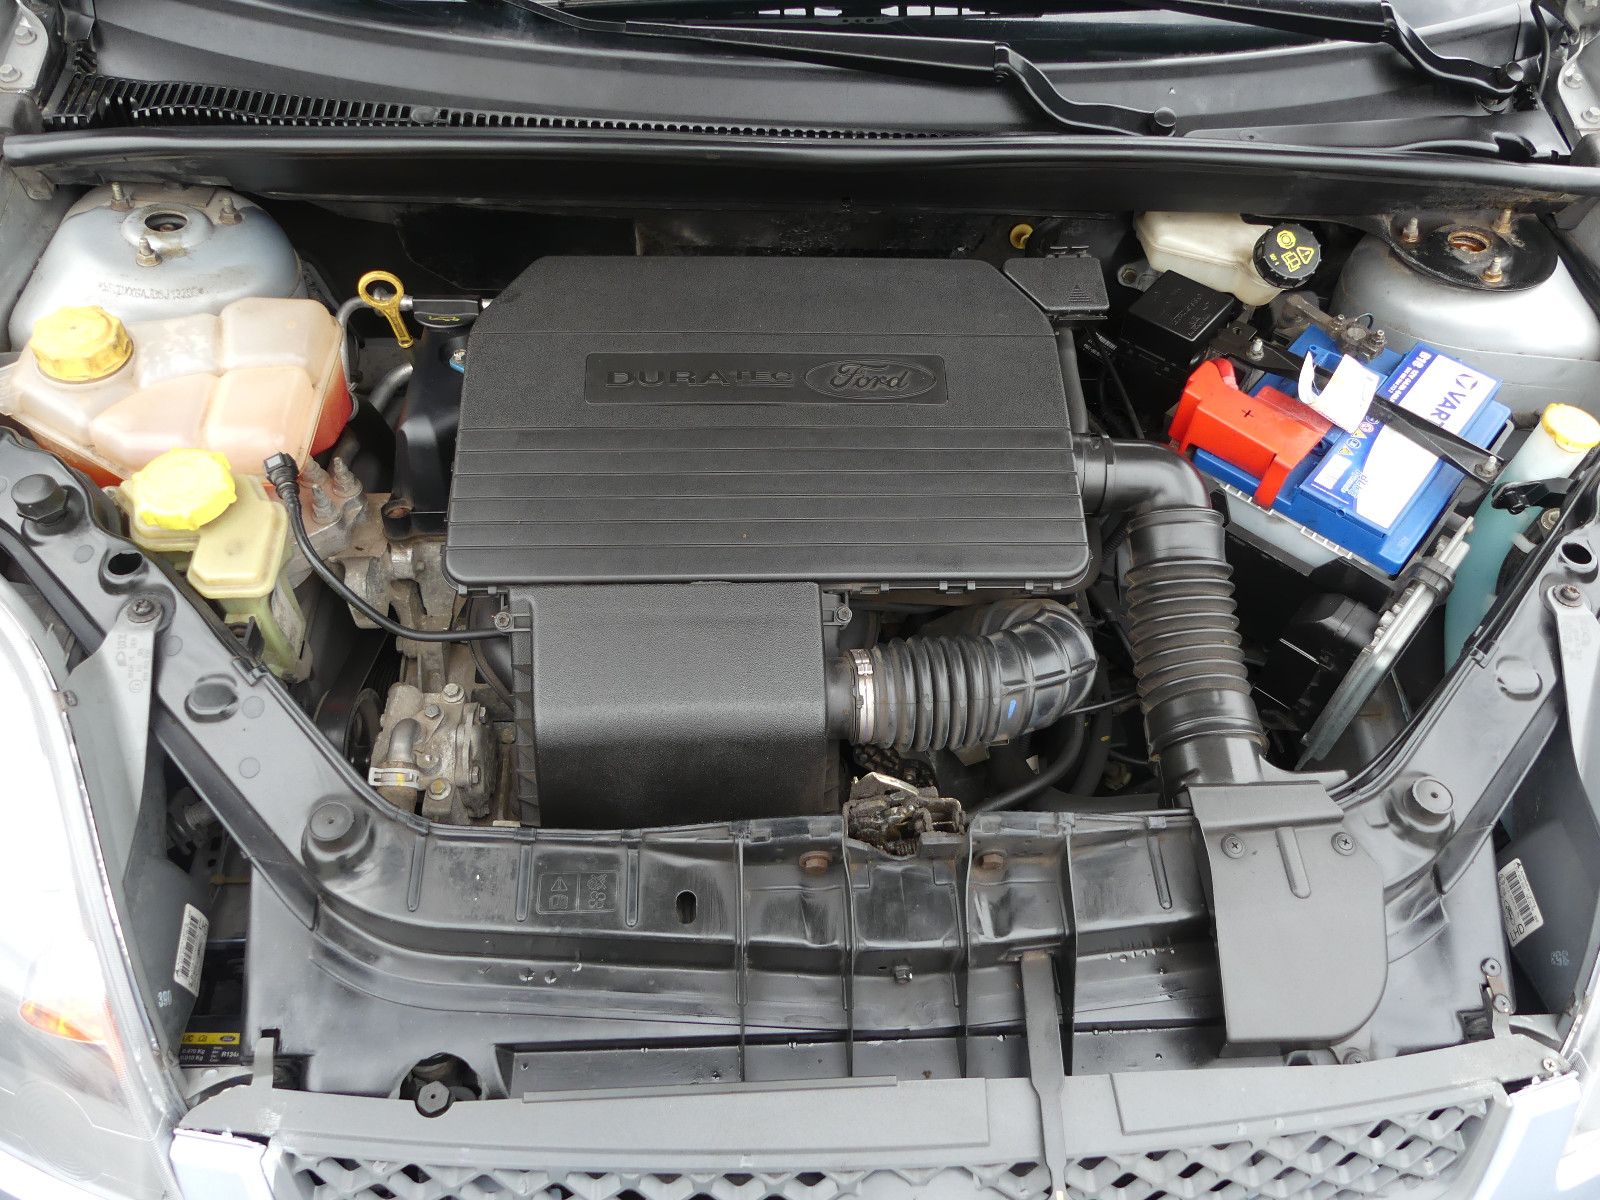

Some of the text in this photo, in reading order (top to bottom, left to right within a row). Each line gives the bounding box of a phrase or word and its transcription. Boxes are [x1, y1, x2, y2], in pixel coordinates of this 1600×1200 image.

[606, 362, 911, 392] DURATEC Ford
[1510, 923, 1525, 942] LHD
